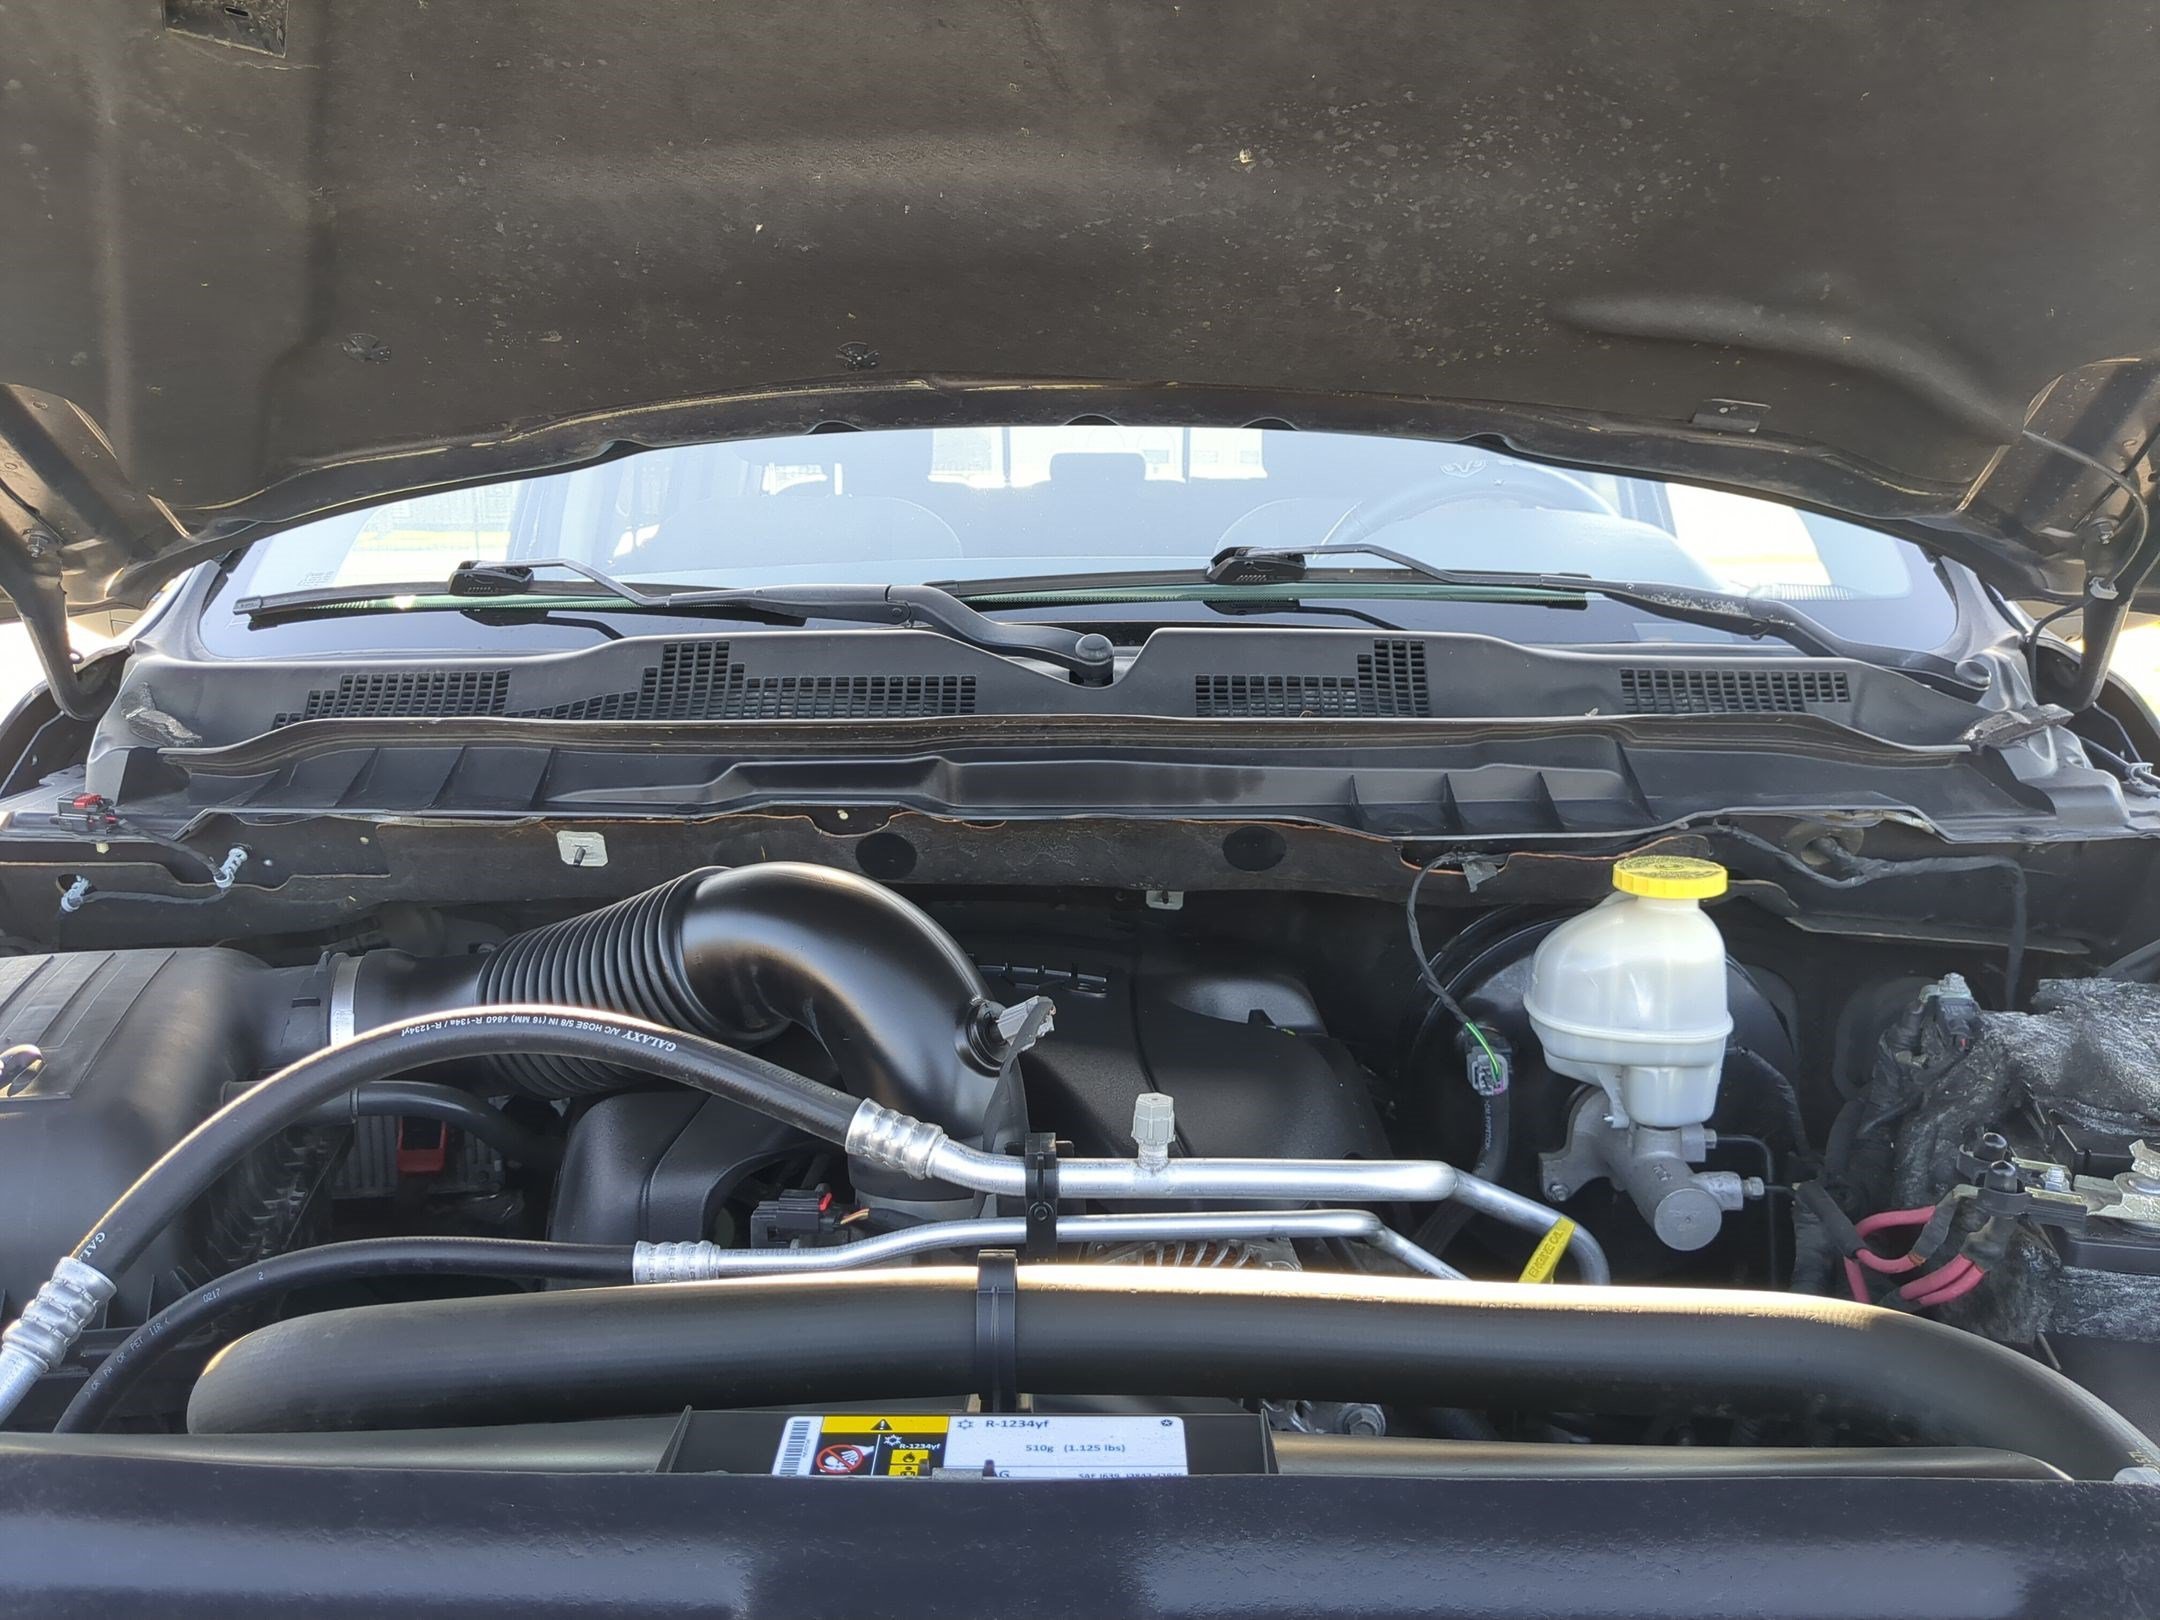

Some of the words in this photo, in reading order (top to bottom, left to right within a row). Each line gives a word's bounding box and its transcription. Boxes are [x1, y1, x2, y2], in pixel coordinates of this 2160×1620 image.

[449, 1016, 483, 1026] R-134a
[486, 1016, 509, 1024] 4860
[510, 1014, 531, 1024] MM)
[532, 1015, 547, 1025] (16
[548, 1017, 559, 1026] IN
[560, 1018, 575, 1028] 5/8
[401, 1022, 442, 1037] R-1234yf
[576, 1020, 603, 1033] HOSE
[604, 1025, 622, 1036] A/C
[622, 1030, 677, 1052] GALAXY
[78, 1232, 106, 1261] GAL
[129, 1336, 144, 1351] PET
[985, 1420, 1050, 1429] R-1234yf
[899, 1443, 940, 1451] R-1234yf
[1025, 1444, 1054, 1453] 510g
[1063, 1444, 1101, 1453] (1.125
[1104, 1443, 1126, 1453] lbs)
